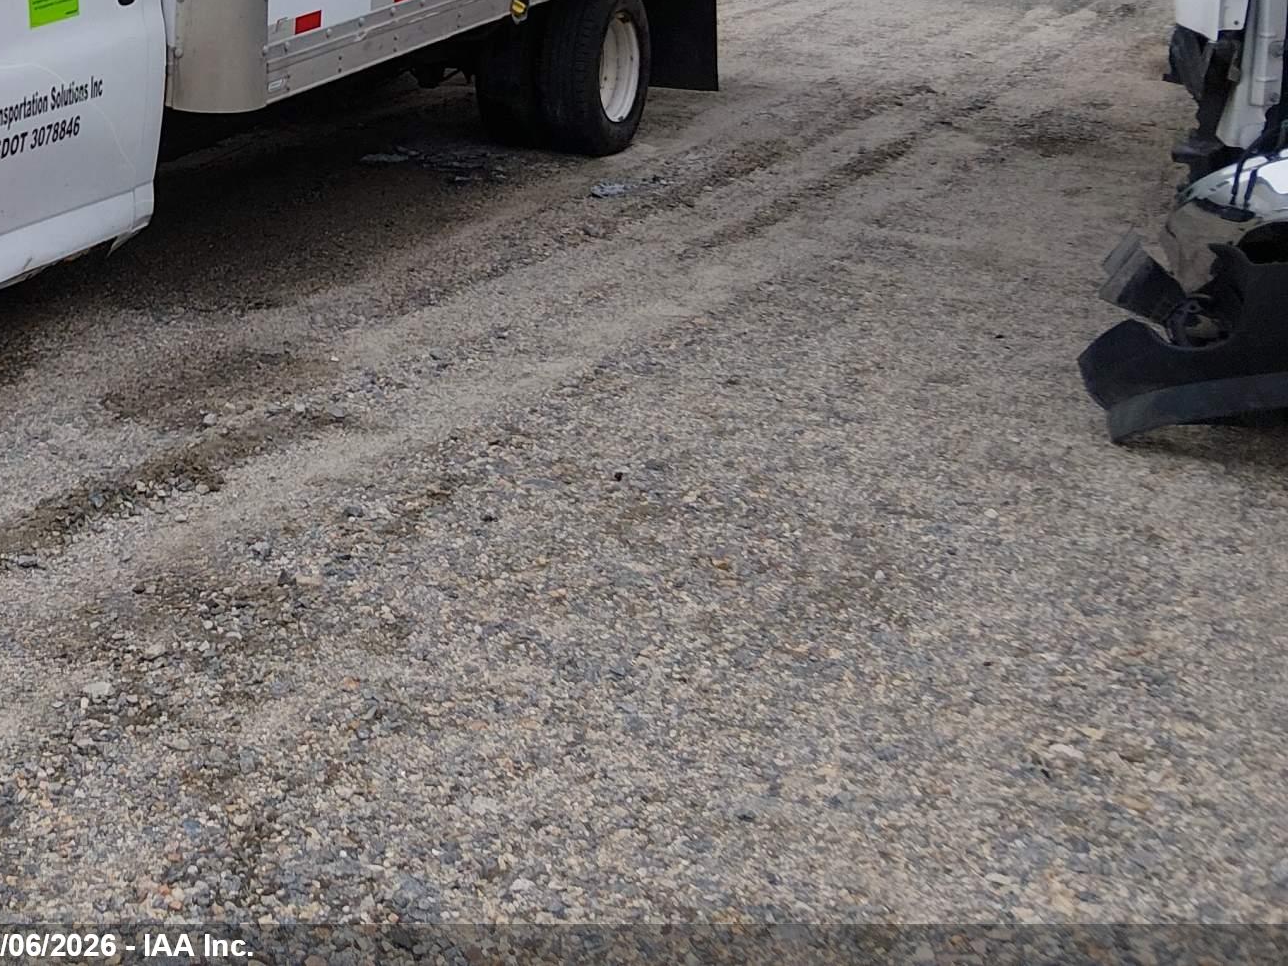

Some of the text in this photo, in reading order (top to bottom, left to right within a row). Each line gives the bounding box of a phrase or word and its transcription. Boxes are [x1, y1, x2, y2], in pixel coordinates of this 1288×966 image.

[50, 81, 88, 111] Solutions
[91, 75, 103, 98] Inc
[30, 115, 81, 149] 3078846
